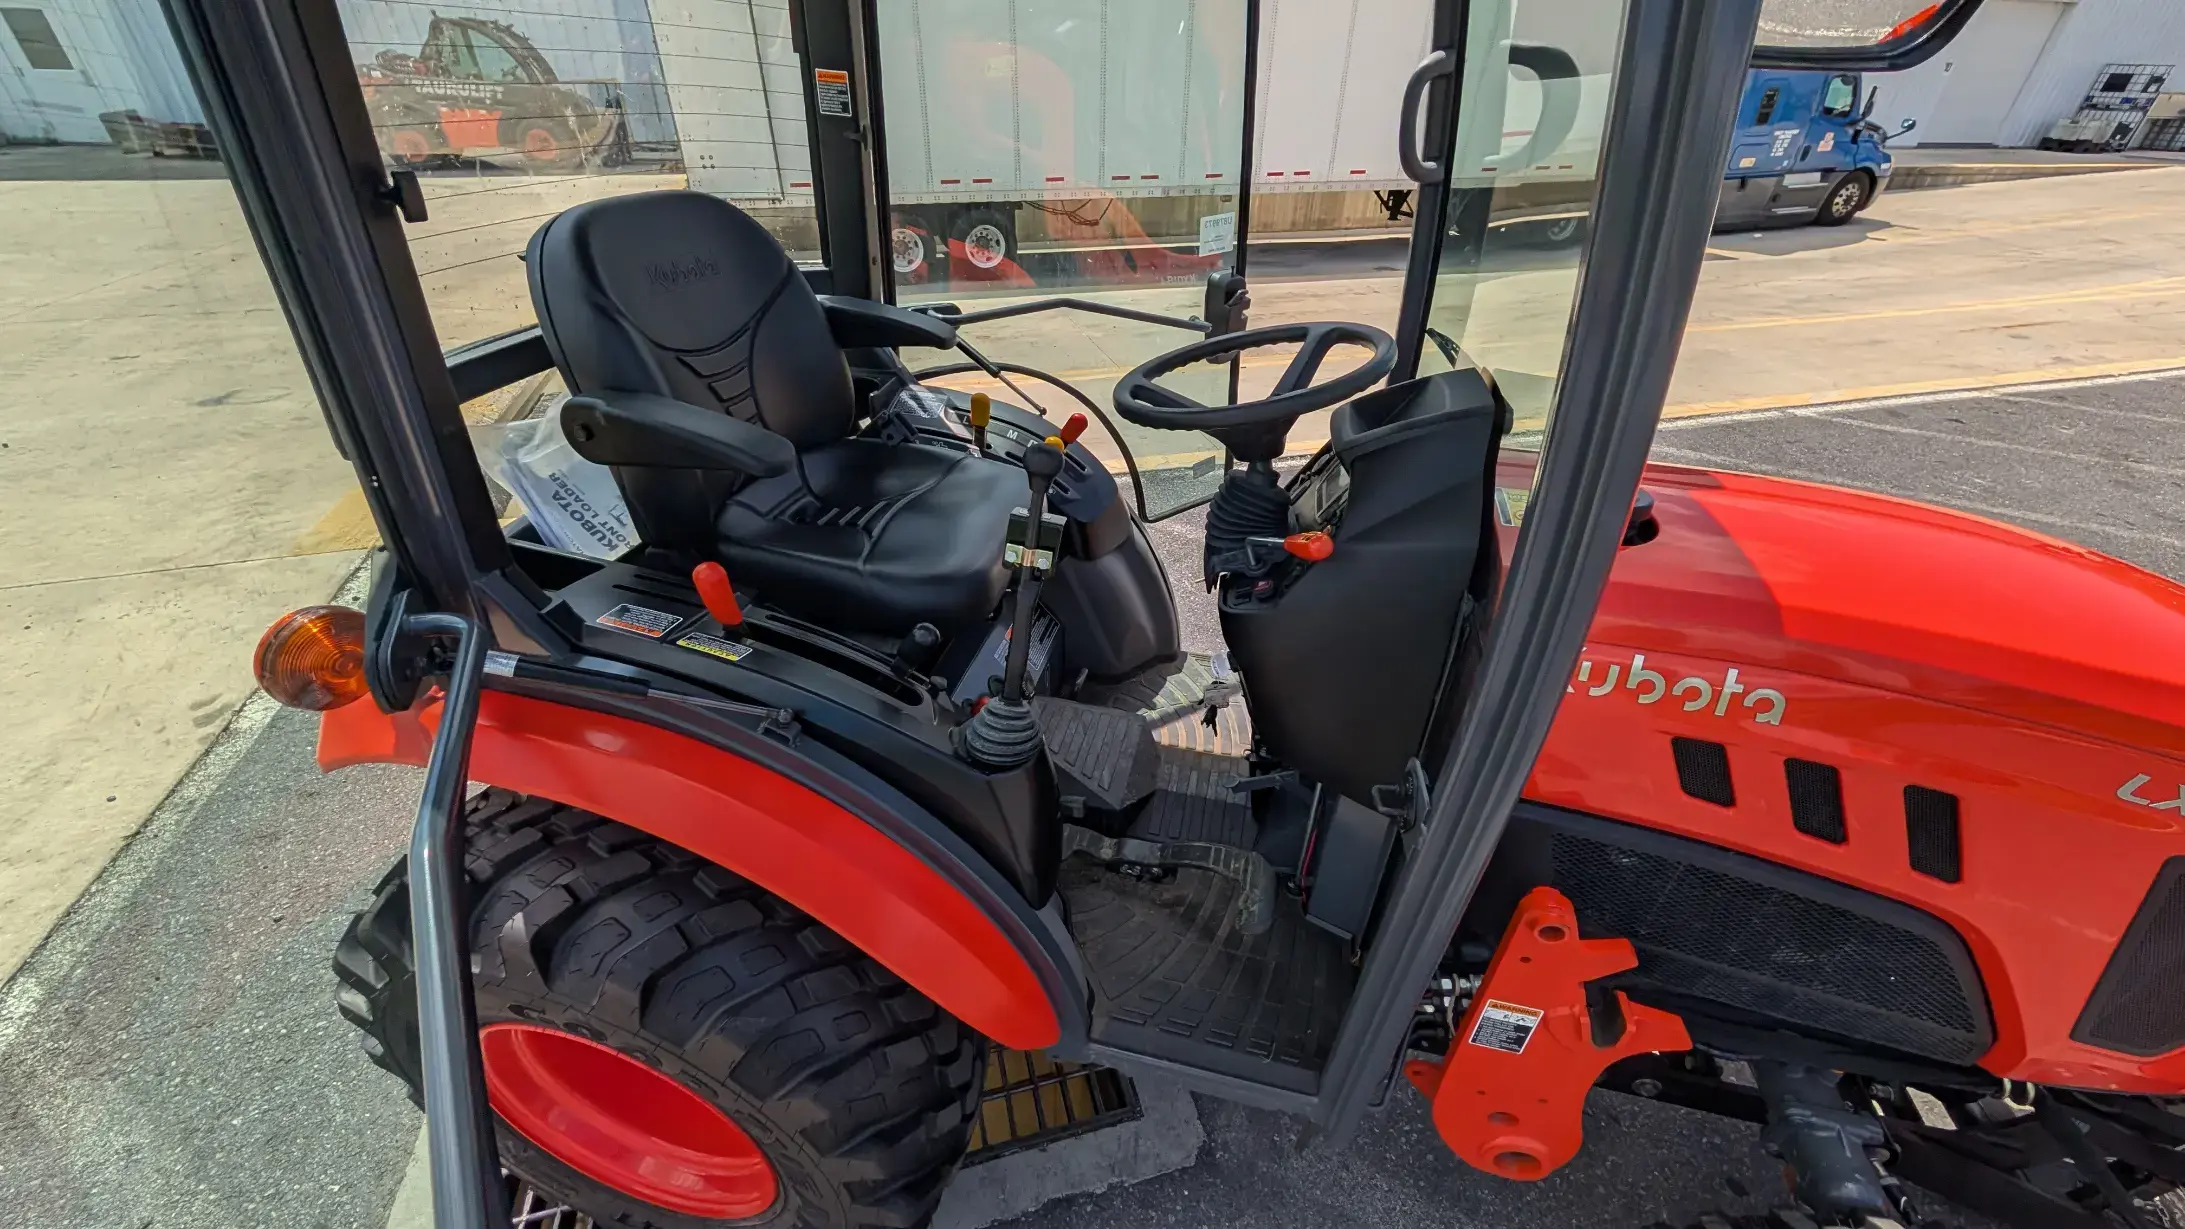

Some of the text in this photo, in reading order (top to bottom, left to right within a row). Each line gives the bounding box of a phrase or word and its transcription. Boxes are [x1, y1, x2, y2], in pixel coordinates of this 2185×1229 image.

[1006, 429, 1019, 440] M
[548, 472, 600, 519] LOADER
[551, 489, 619, 552] KUBOTA
[598, 519, 636, 549] RONT
